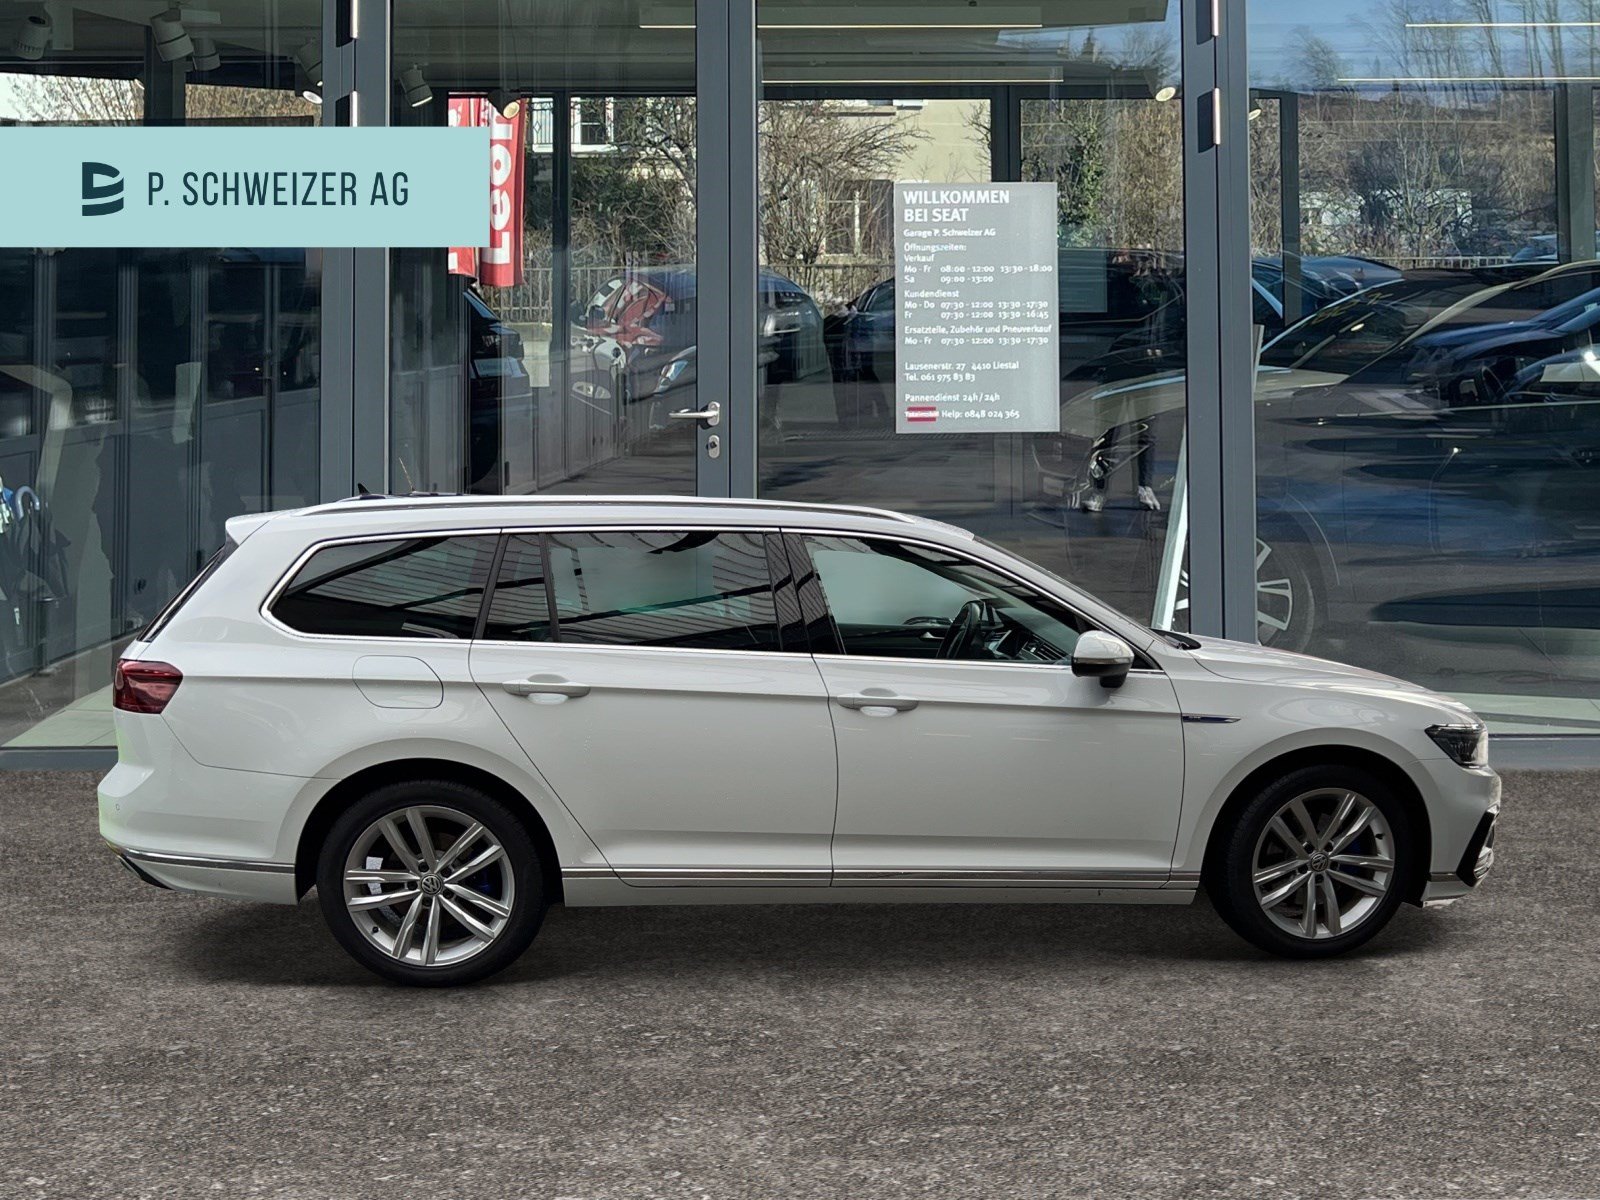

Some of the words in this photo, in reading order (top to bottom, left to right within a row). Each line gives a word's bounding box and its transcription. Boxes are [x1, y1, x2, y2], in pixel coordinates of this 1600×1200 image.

[903, 190, 1010, 204] WILLKOMMEN
[904, 208, 928, 222] BEI
[932, 208, 969, 222] SEAT
[903, 229, 933, 238] Garage
[934, 229, 942, 237] P.
[942, 228, 983, 237] Schweizer
[984, 228, 996, 237] AG
[904, 242, 967, 253] Öffnungszeiten:
[904, 254, 935, 262] Verkauf
[904, 265, 918, 273] Mo
[923, 265, 932, 273] Fr
[940, 265, 966, 273] 08:00
[972, 265, 995, 273] 12:00
[1000, 265, 1023, 274] 13:30
[1029, 264, 1053, 273] 18:00
[904, 275, 915, 283] Sa
[940, 276, 965, 284] 09:00
[972, 275, 994, 284] 13:00
[904, 289, 960, 298] Kundendienst
[904, 301, 918, 309] Mo
[924, 301, 935, 309] Do
[940, 302, 964, 310] 07:30
[998, 301, 1021, 309] 13:30
[1026, 301, 1049, 309] 17:30
[904, 311, 912, 319] Fr
[940, 312, 964, 320] 07:30
[998, 311, 1021, 319] 13:30
[1026, 310, 1049, 319] 16:45
[904, 325, 949, 334] Ersatzteile,
[950, 325, 983, 333] Zubehör
[985, 325, 1000, 333] und
[1002, 324, 1052, 333] Pneuverkauf
[904, 337, 918, 345] Mo
[940, 338, 964, 346] 07:30
[998, 337, 1021, 346] 13:30
[1027, 337, 1049, 345] 17:30
[904, 362, 954, 371] Lausenerstr.
[956, 363, 966, 371] 27
[971, 363, 991, 371] 4410
[993, 361, 1019, 370] Liestal
[904, 373, 919, 381] Tel.
[920, 372, 935, 381] 061
[937, 373, 951, 382] 975
[953, 372, 963, 382] 83
[965, 372, 976, 382] 83
[904, 393, 960, 402] Pannendienst
[963, 393, 978, 402] 24h
[984, 392, 1000, 402] 24h
[941, 410, 962, 419] Help:
[964, 410, 986, 419] 0848
[987, 411, 1003, 419] 024
[1004, 409, 1020, 419] 365
